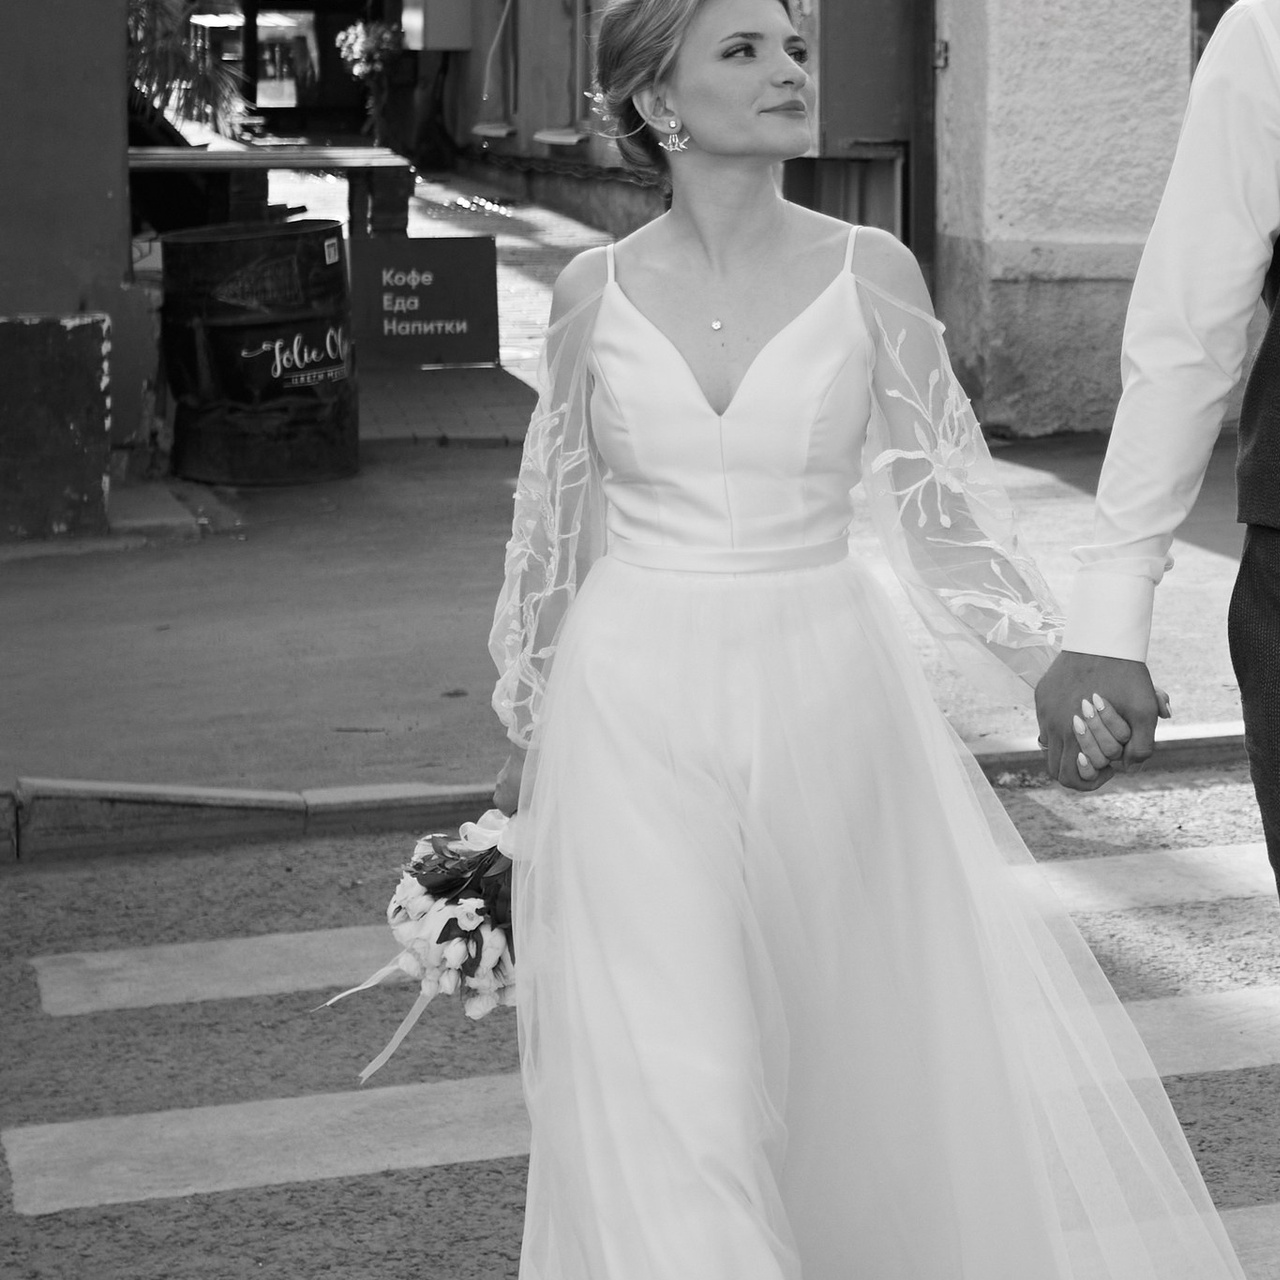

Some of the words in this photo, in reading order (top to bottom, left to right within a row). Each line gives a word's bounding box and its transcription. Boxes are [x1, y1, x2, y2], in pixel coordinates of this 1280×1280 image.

[382, 267, 434, 290] Кофе
[382, 292, 420, 314] Еда
[383, 317, 468, 336] Напитки
